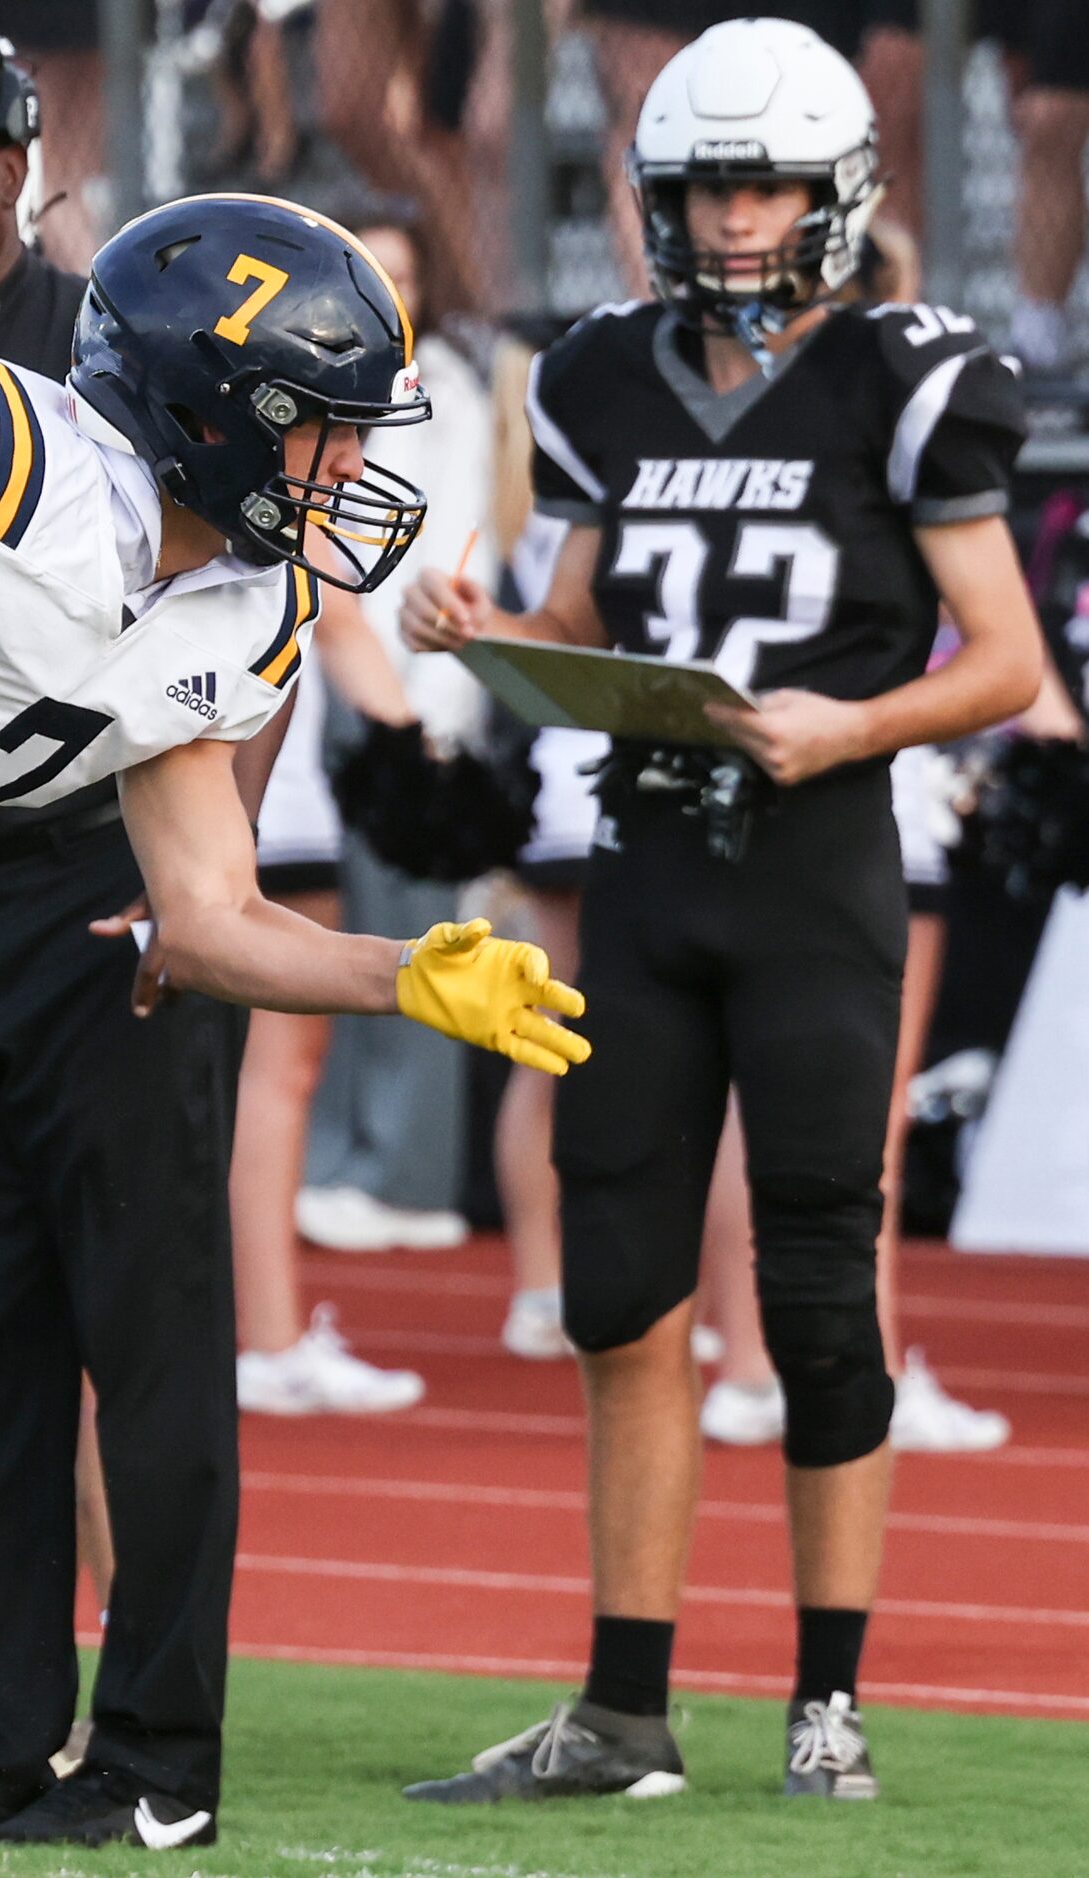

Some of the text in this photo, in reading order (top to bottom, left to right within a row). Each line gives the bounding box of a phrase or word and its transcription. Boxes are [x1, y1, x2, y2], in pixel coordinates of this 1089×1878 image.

[213, 253, 290, 347] 7
[621, 459, 815, 511] HAWKS
[611, 518, 839, 694] 32
[166, 685, 218, 720] adidas
